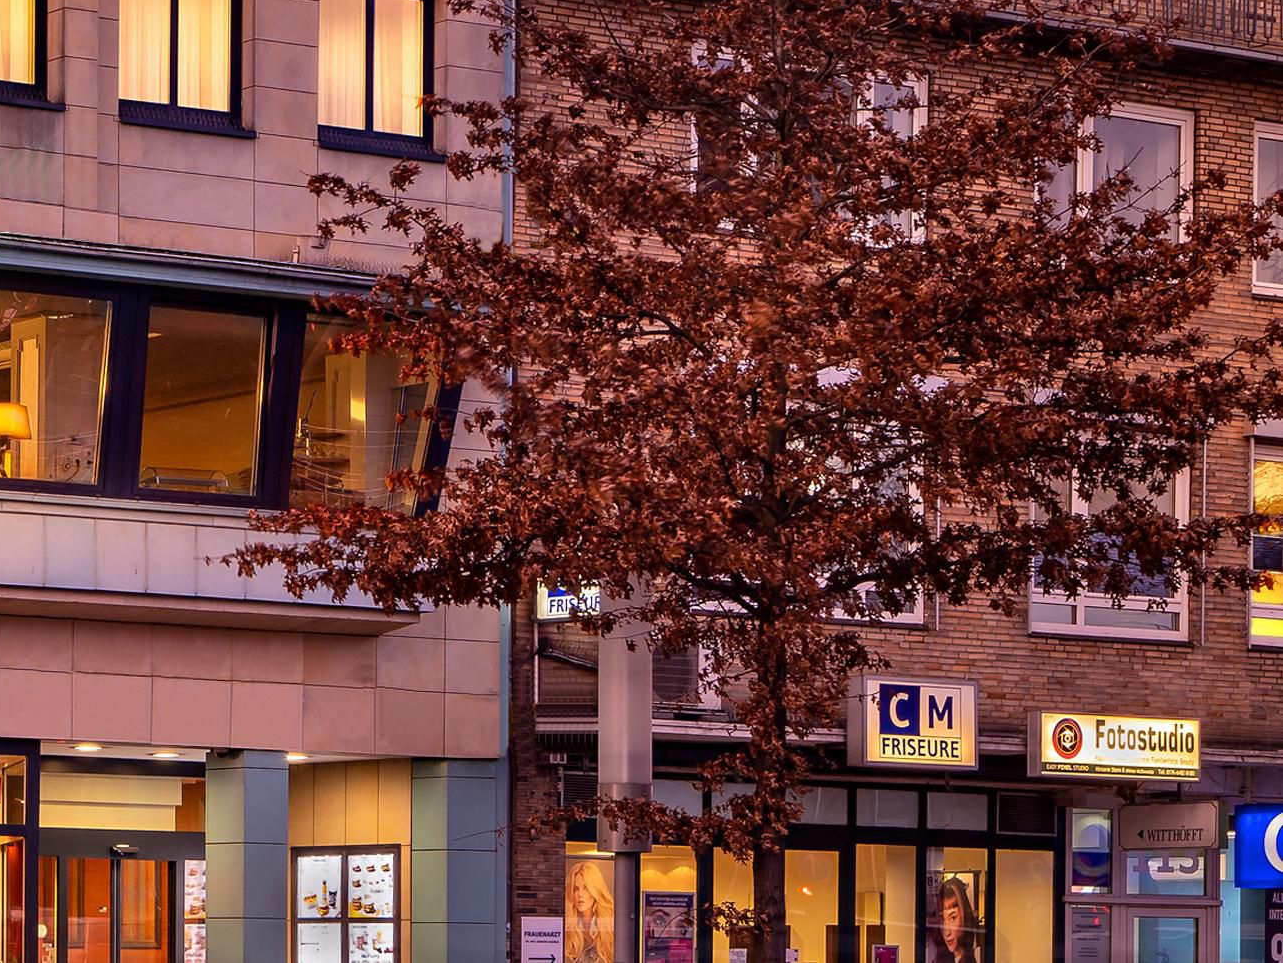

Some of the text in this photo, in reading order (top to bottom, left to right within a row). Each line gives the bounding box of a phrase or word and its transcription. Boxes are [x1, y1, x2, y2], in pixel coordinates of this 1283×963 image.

[889, 692, 953, 730] C M
[882, 737, 960, 759] FRISEURE
[1095, 719, 1195, 753] Fotostudio
[1147, 825, 1204, 842] WITTHÖFFT
